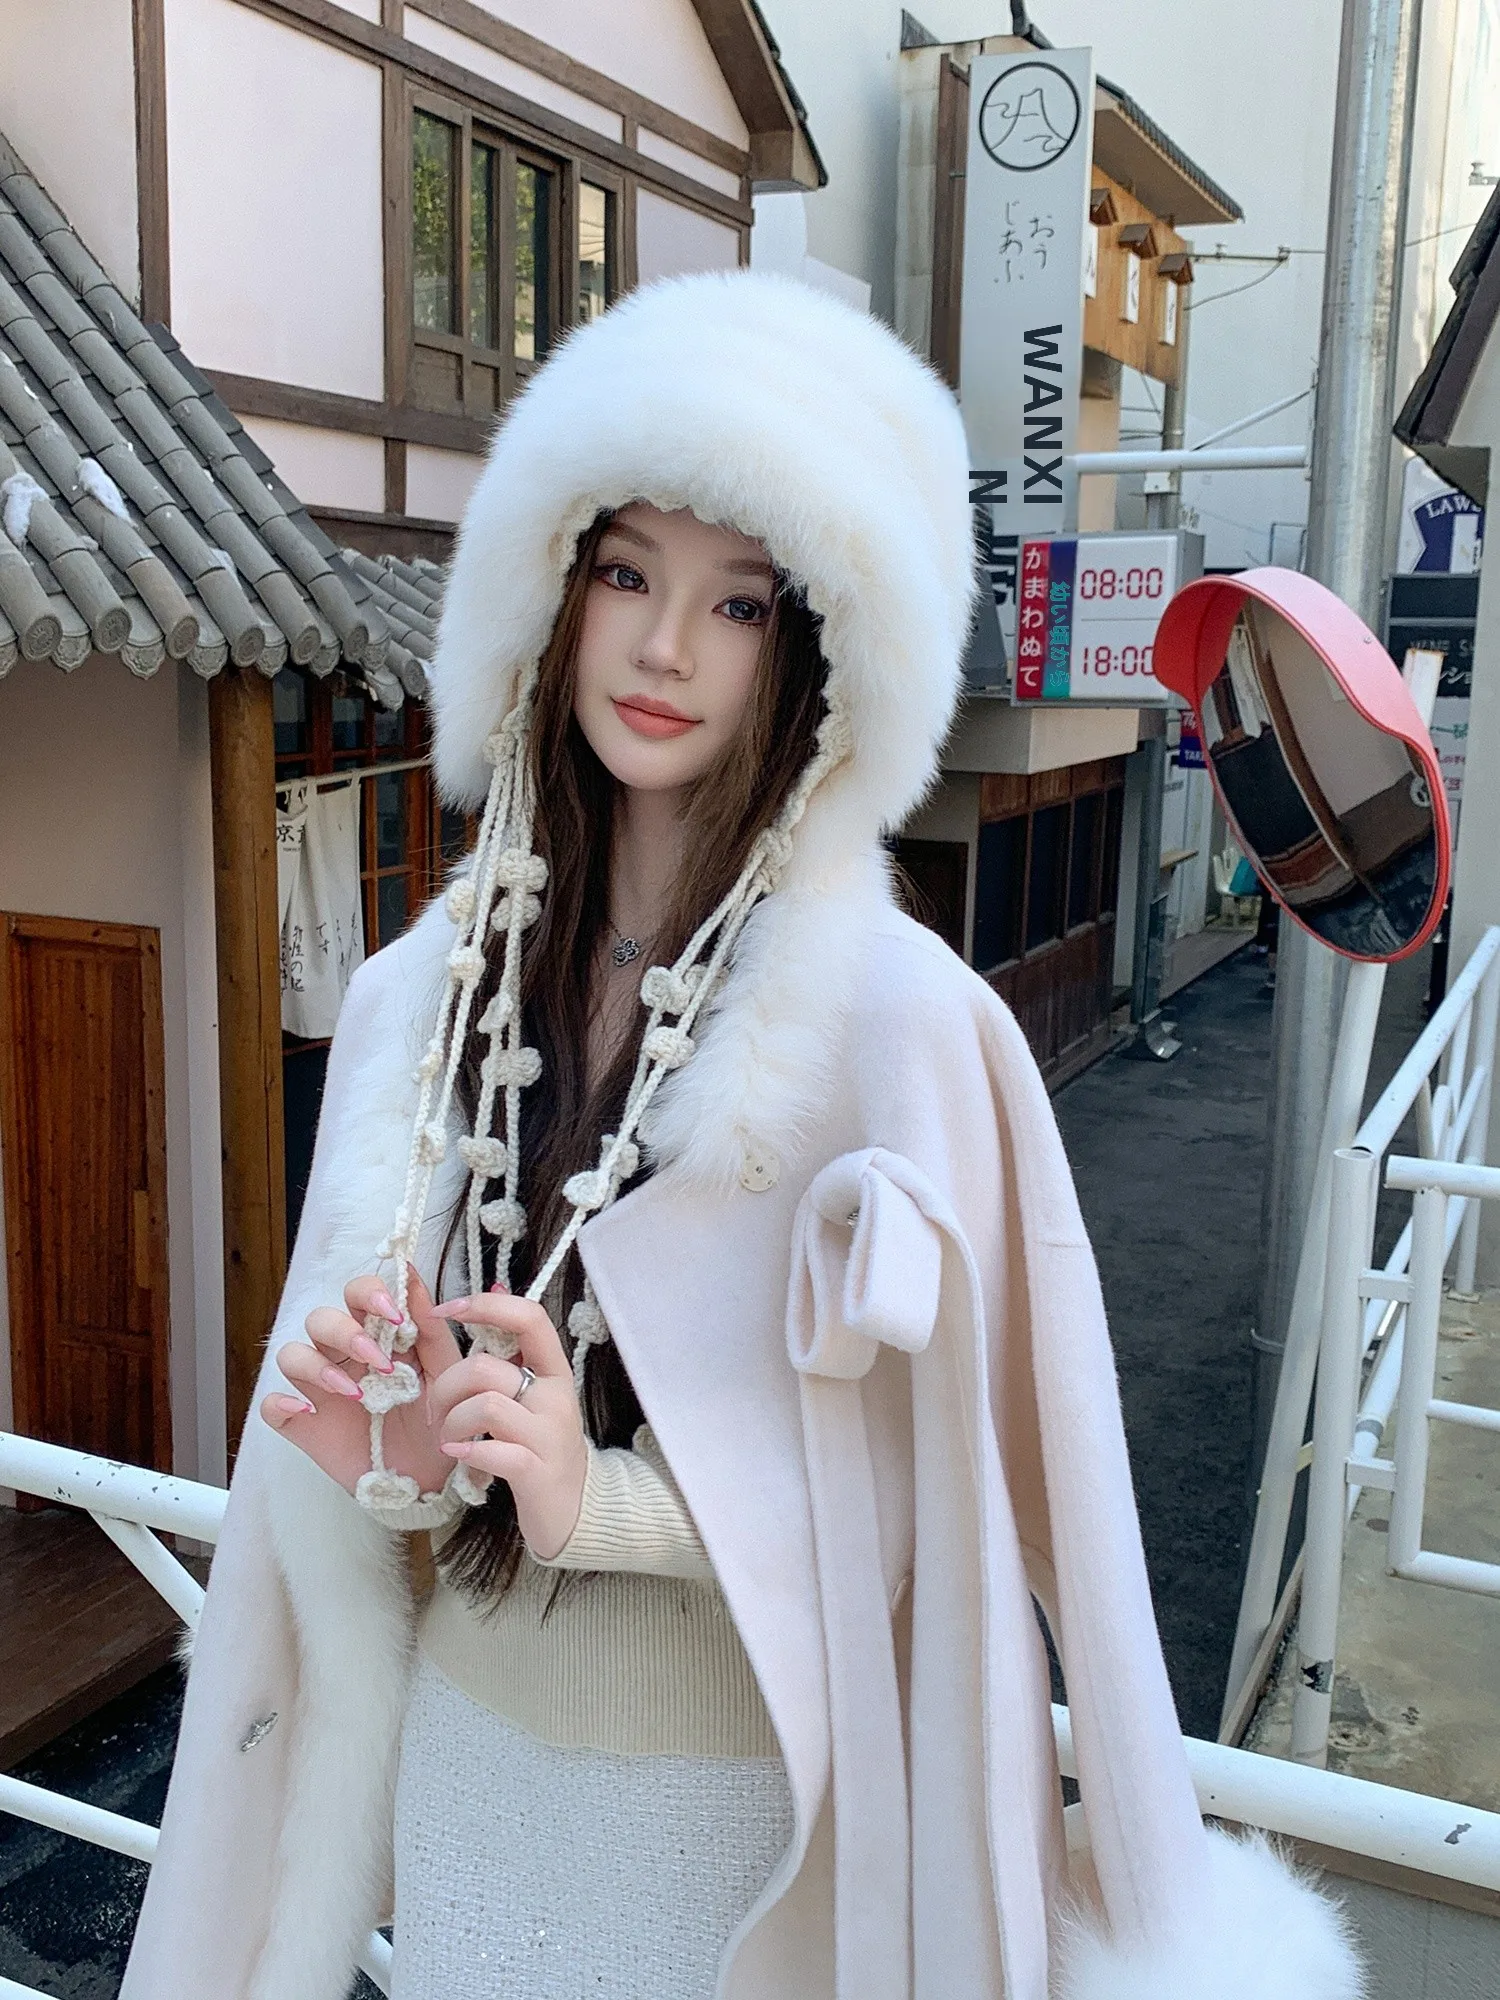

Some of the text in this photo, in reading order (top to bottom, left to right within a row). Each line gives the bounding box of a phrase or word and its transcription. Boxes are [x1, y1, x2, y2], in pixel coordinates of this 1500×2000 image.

[1020, 546, 1045, 687] かまわぬて
[1050, 581, 1070, 686] 幼い頃から
[1081, 568, 1162, 599] 08:00
